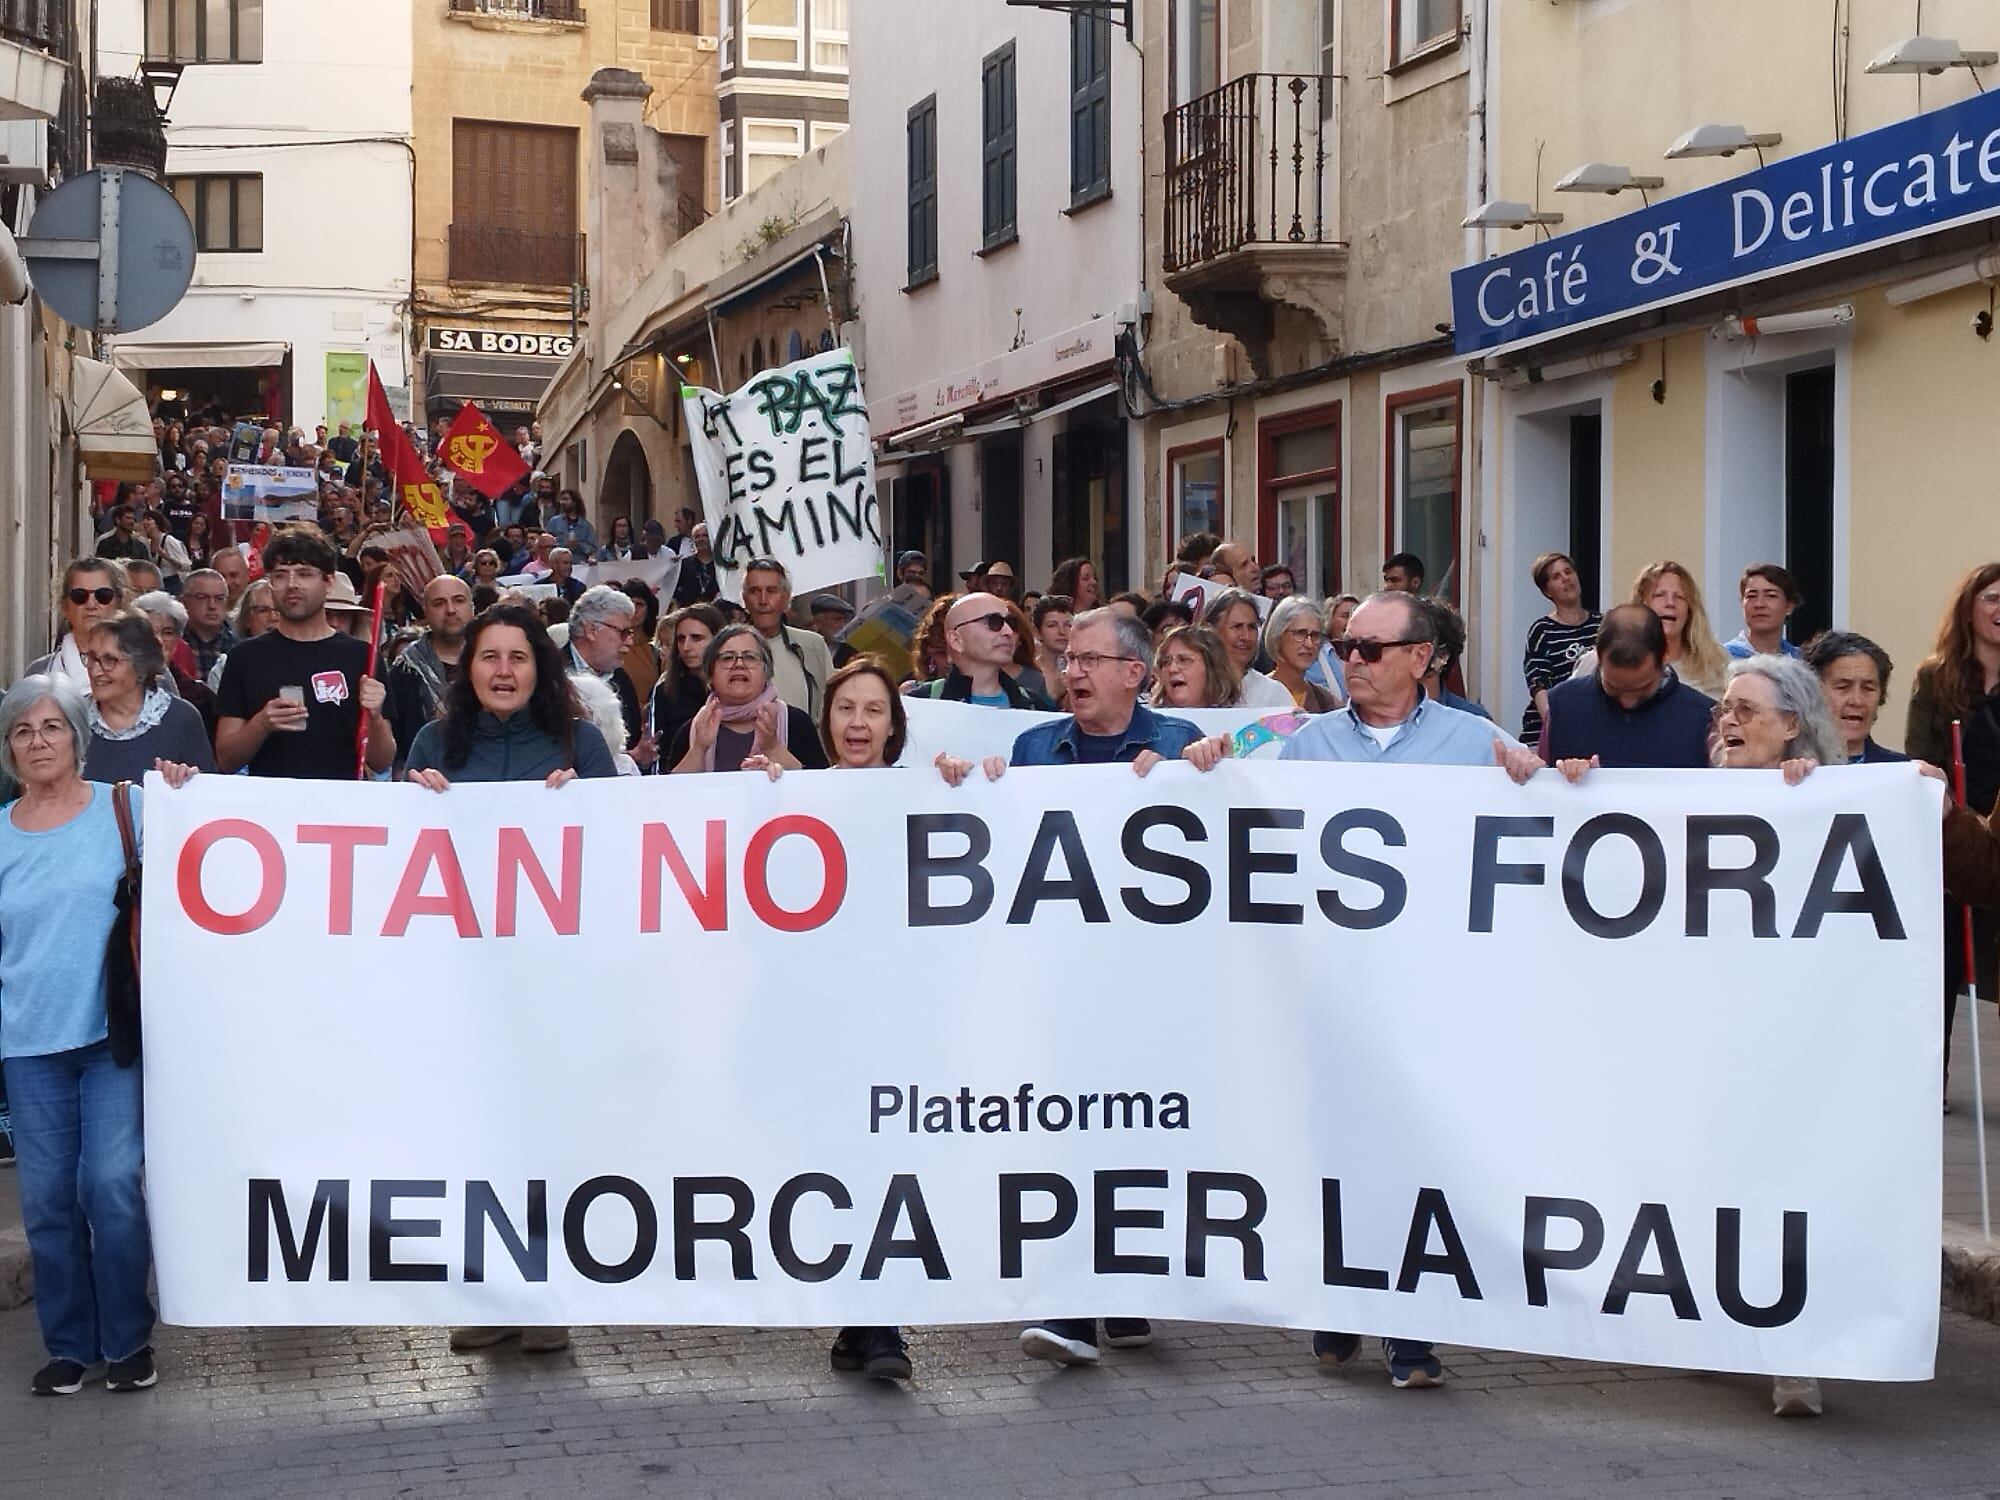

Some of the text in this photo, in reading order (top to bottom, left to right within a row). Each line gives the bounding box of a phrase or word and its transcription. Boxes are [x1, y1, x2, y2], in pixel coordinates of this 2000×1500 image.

[1477, 243, 1589, 328] Café
[1630, 221, 1683, 286] &
[439, 330, 475, 352] SA
[749, 363, 871, 438] PAZ
[726, 436, 867, 504] ES EL
[177, 804, 1908, 941] OTAN NO BASES FORA
[870, 1083, 1190, 1134] Plataforma
[247, 1168, 1808, 1329] MENORCA PER LA PAU
